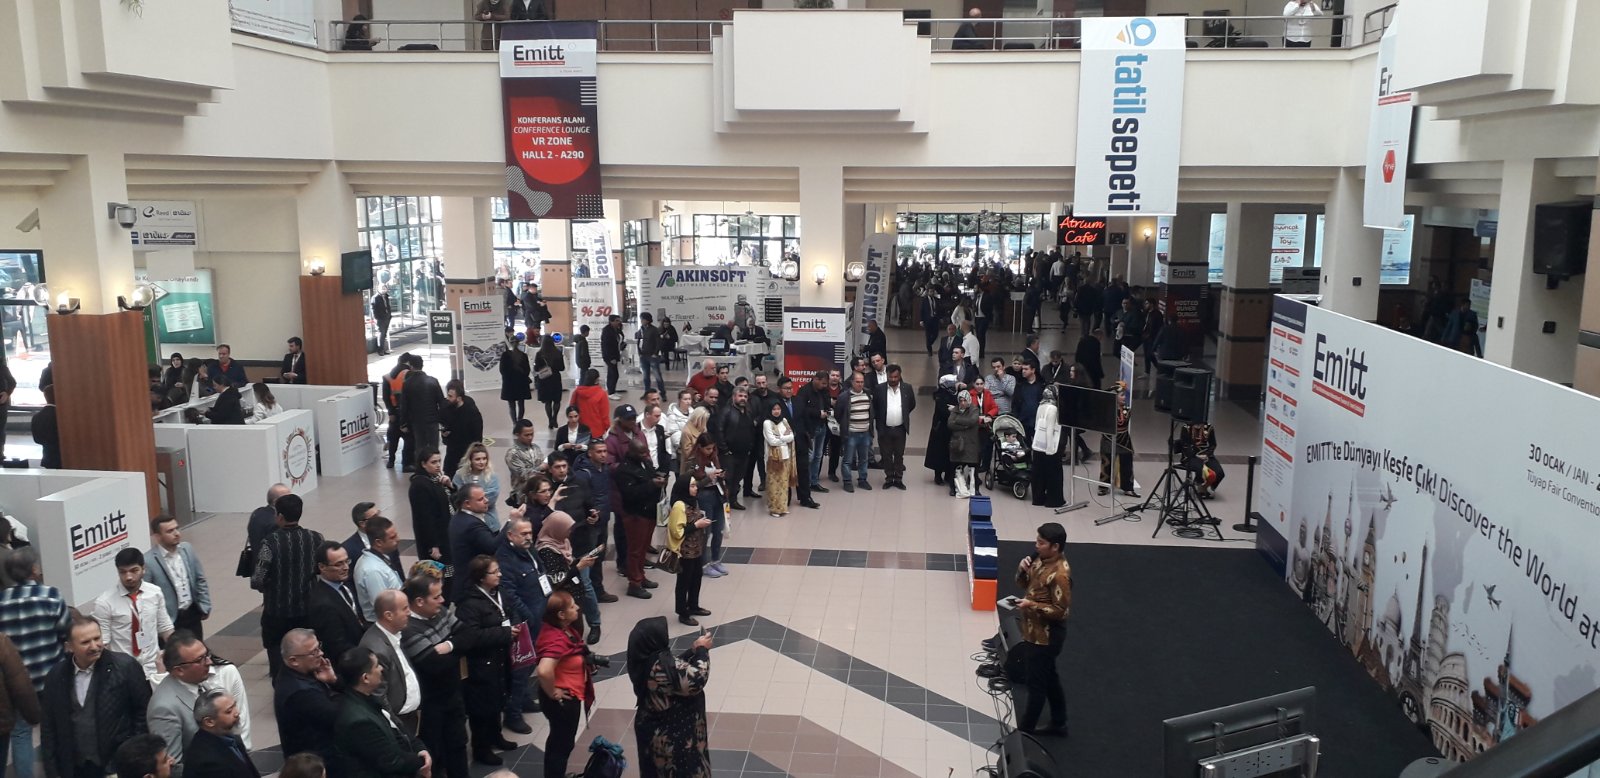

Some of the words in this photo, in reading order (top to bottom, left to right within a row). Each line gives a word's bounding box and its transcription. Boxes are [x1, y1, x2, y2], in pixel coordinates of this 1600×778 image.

[513, 45, 565, 61] Emitt
[517, 116, 562, 124] KONFERANS
[563, 116, 586, 124] ALANI
[513, 126, 560, 134] CONFERENCE
[561, 126, 591, 134] LOUNGE
[1104, 53, 1149, 211] tatilsepeti
[532, 137, 546, 146] VR
[547, 137, 573, 146] ZONE
[522, 151, 546, 159] HALL
[547, 151, 553, 159] 2
[560, 151, 585, 159] A290
[1059, 216, 1106, 230] Atrium
[676, 269, 748, 282] AKINSOFT
[1171, 268, 1197, 276] Emitt
[463, 300, 492, 311] Emitt
[790, 317, 827, 330] Emitt
[1312, 332, 1368, 400] Emitt
[339, 412, 370, 438] Emitt
[1528, 443, 1542, 463] 30
[1572, 466, 1589, 485] JAN
[1547, 479, 1562, 496] Fair
[69, 509, 128, 553] Emitt
[1343, 440, 1381, 472] Dünyayı
[1383, 448, 1413, 482] Keşfe
[1415, 463, 1438, 495] Çık!
[1438, 477, 1497, 541] Discover
[1497, 525, 1533, 568] the
[1526, 548, 1579, 623] World
[1579, 613, 1600, 650] at
